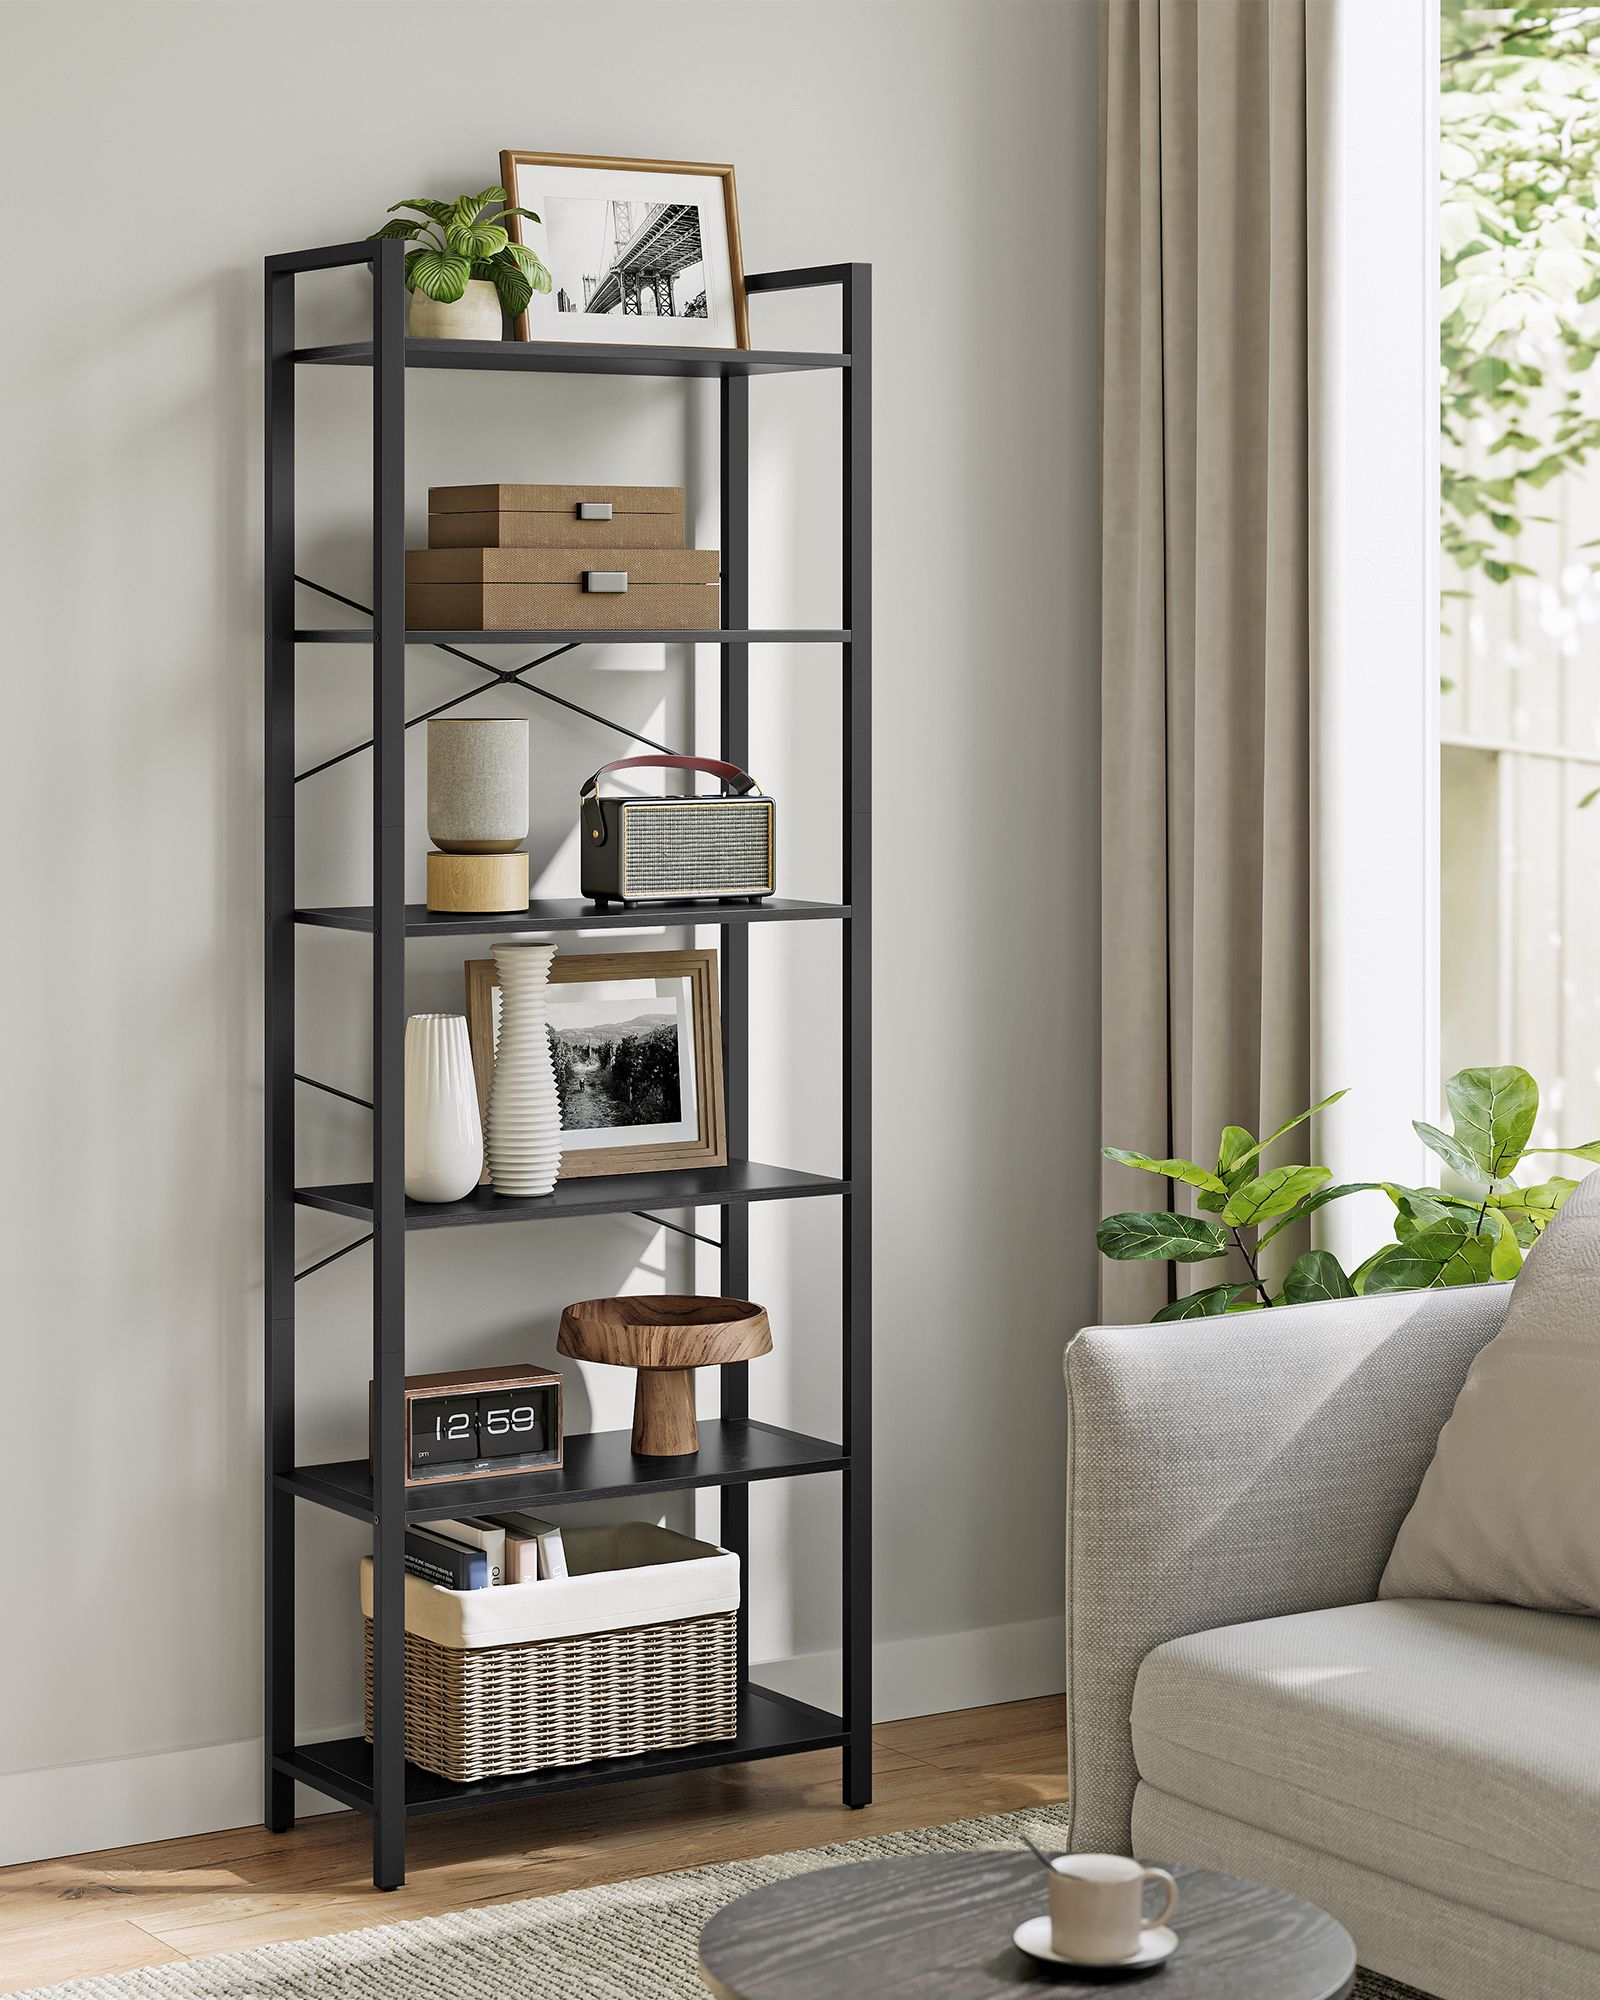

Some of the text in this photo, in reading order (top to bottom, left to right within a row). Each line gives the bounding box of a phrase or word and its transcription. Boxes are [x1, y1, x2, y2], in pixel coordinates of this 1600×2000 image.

[435, 1406, 535, 1441] 12 59
[418, 1451, 430, 1459] pm
